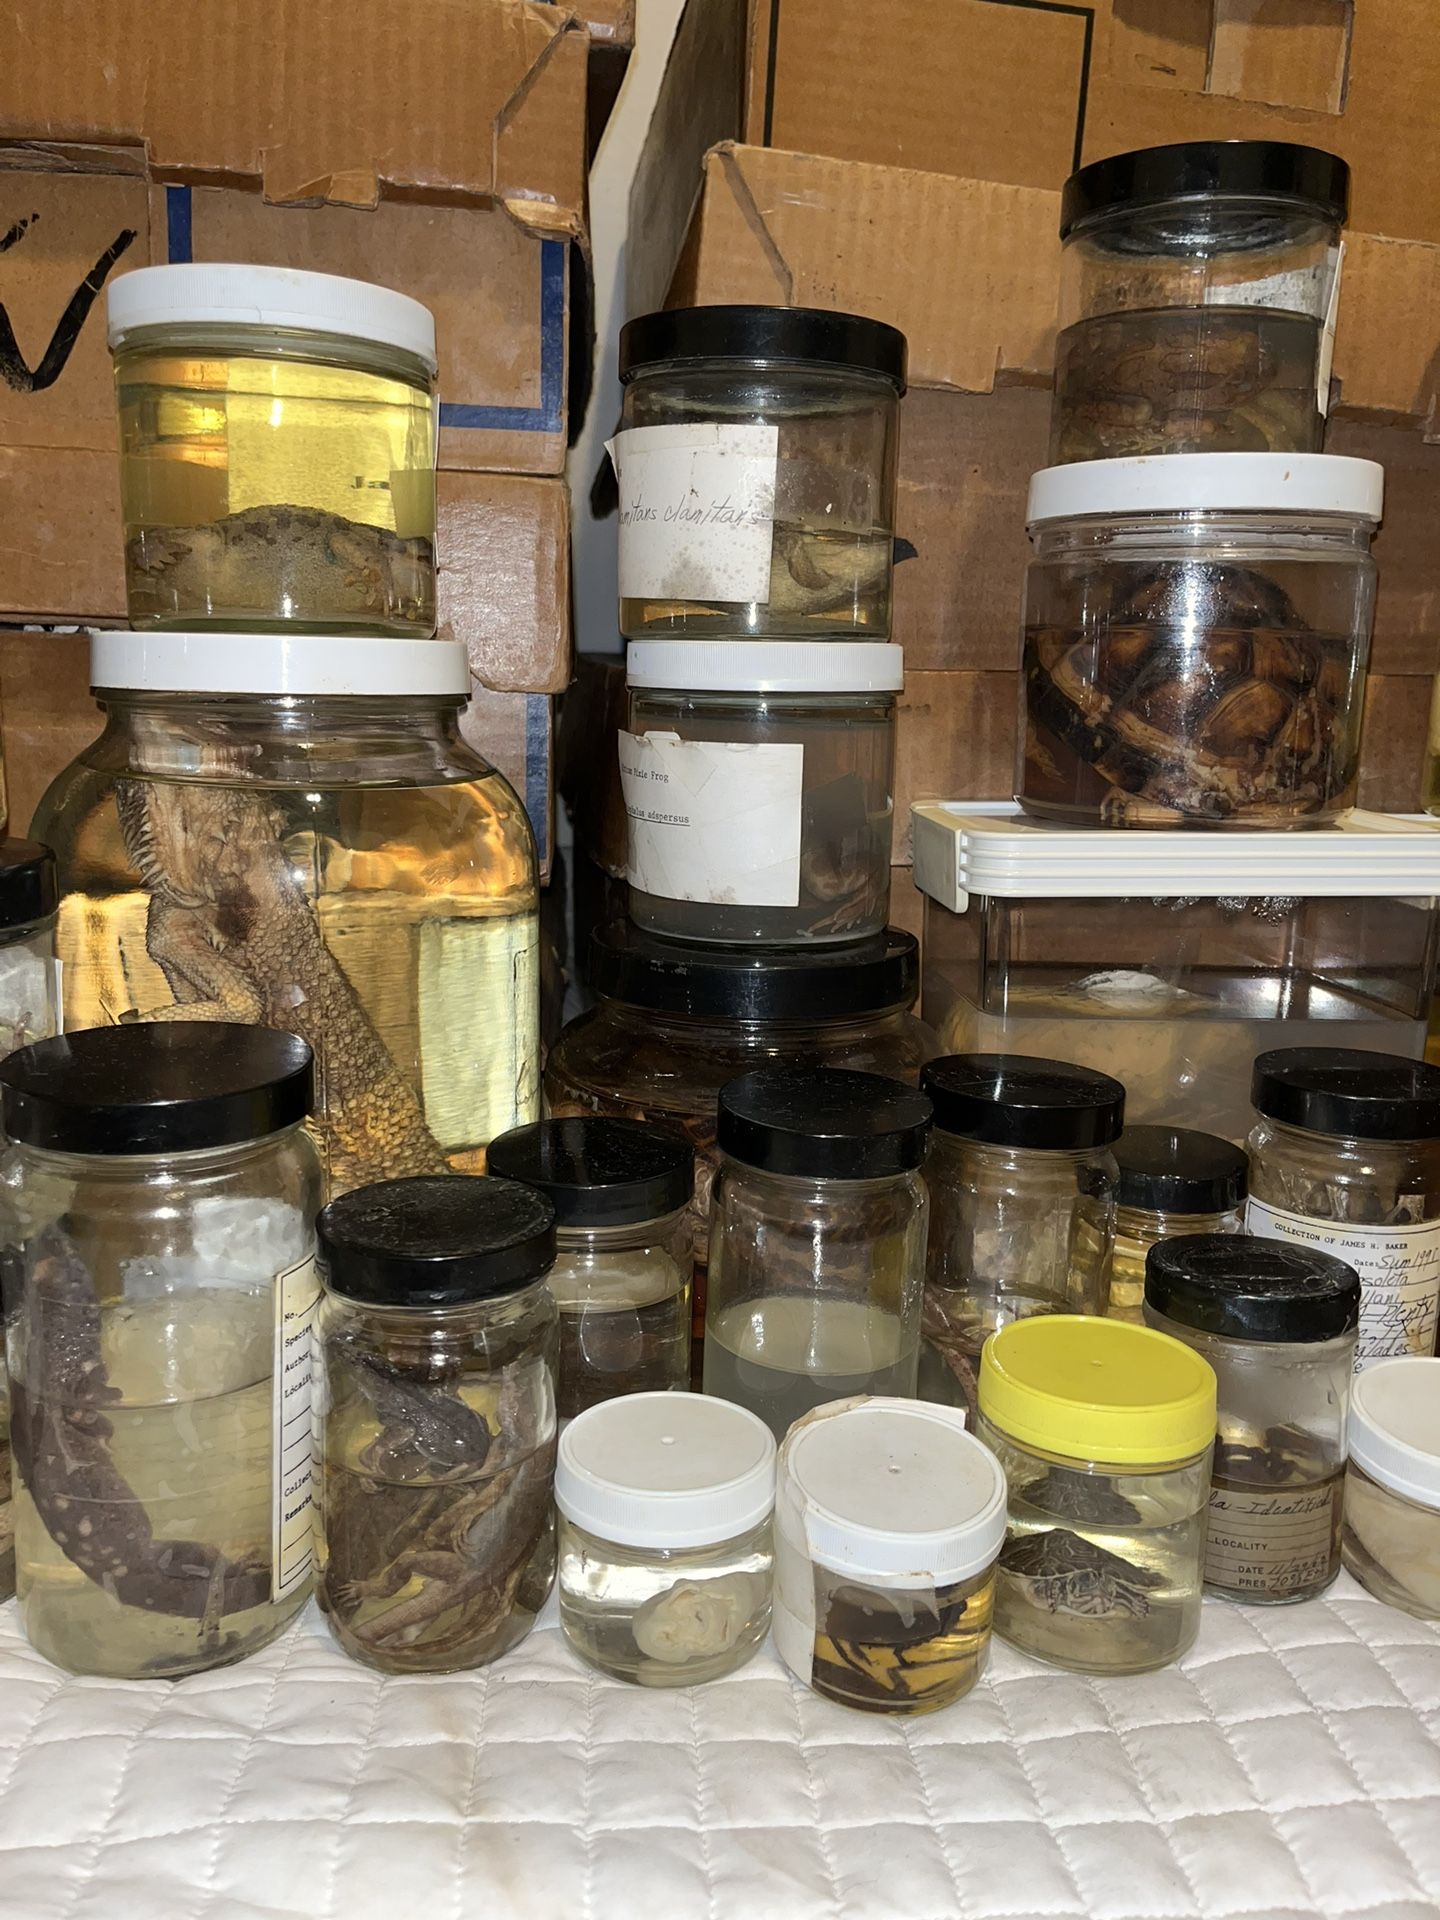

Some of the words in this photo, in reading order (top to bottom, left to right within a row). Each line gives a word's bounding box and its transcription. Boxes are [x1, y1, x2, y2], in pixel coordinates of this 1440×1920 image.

[650, 770, 669, 784] Frog
[647, 810, 690, 823] adspersus
[1274, 1222, 1321, 1242] COLLECTION
[1324, 1236, 1336, 1245] OF
[1340, 1238, 1366, 1249] JAMES
[1214, 1537, 1269, 1551] LOCALITY
[1238, 1565, 1264, 1575] DATE
